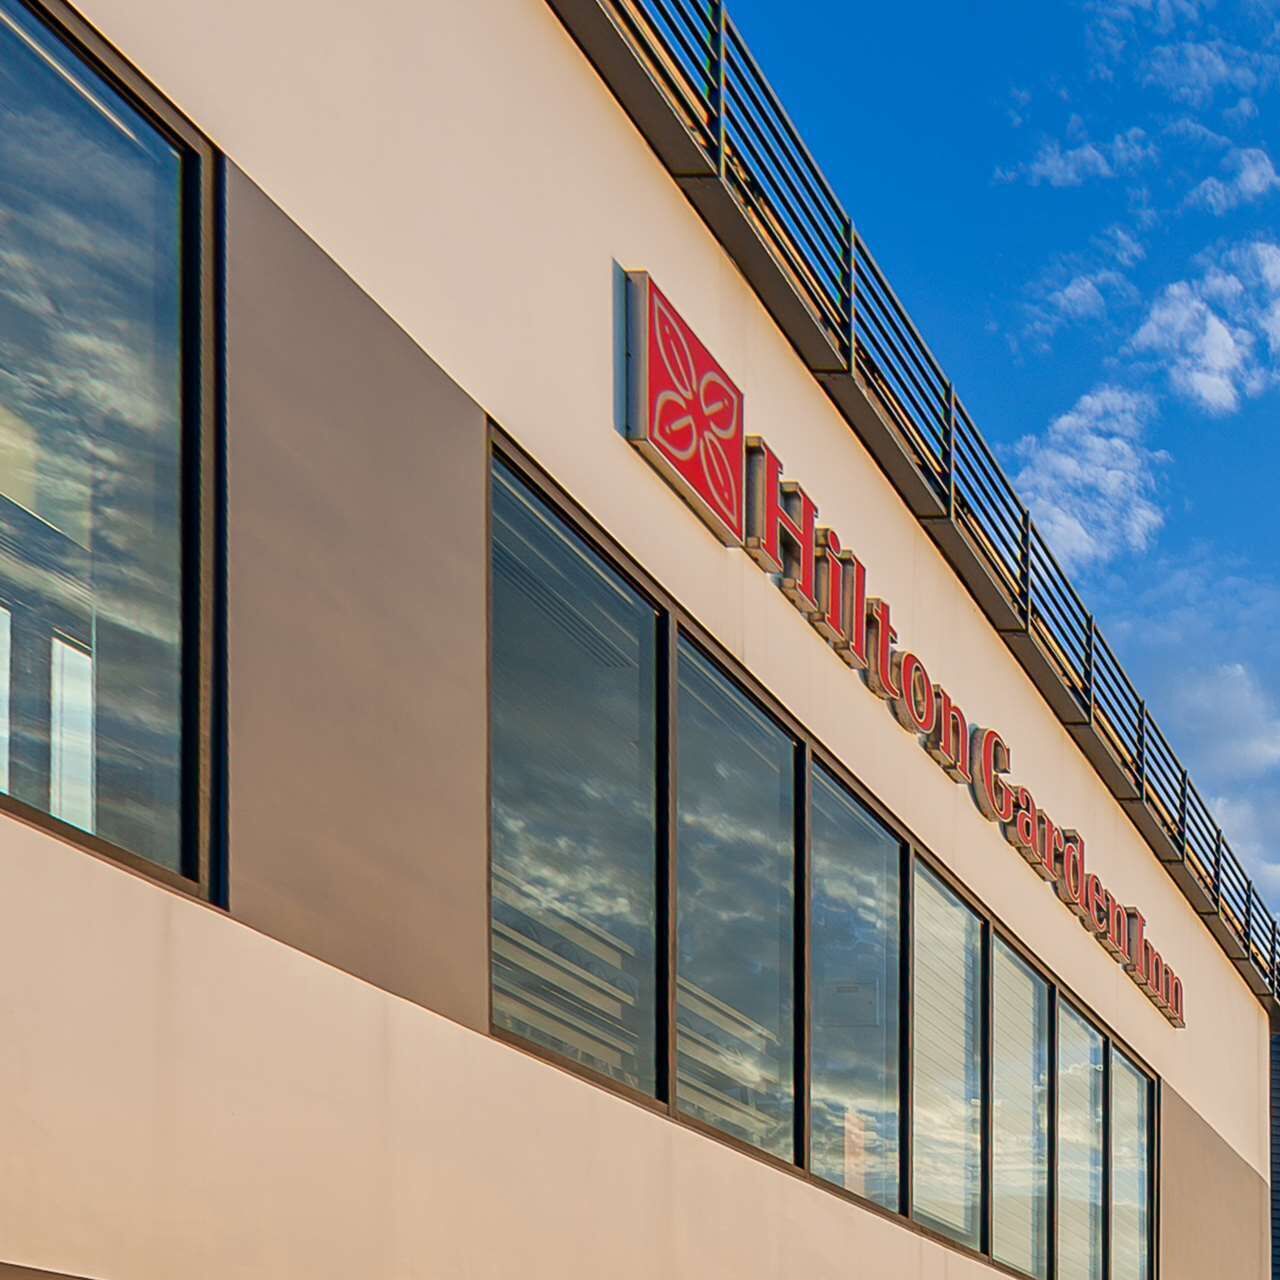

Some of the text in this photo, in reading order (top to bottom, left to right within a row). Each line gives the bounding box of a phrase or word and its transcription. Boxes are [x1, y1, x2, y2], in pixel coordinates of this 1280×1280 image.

[755, 437, 1185, 1027] Hilton Garden Inn
